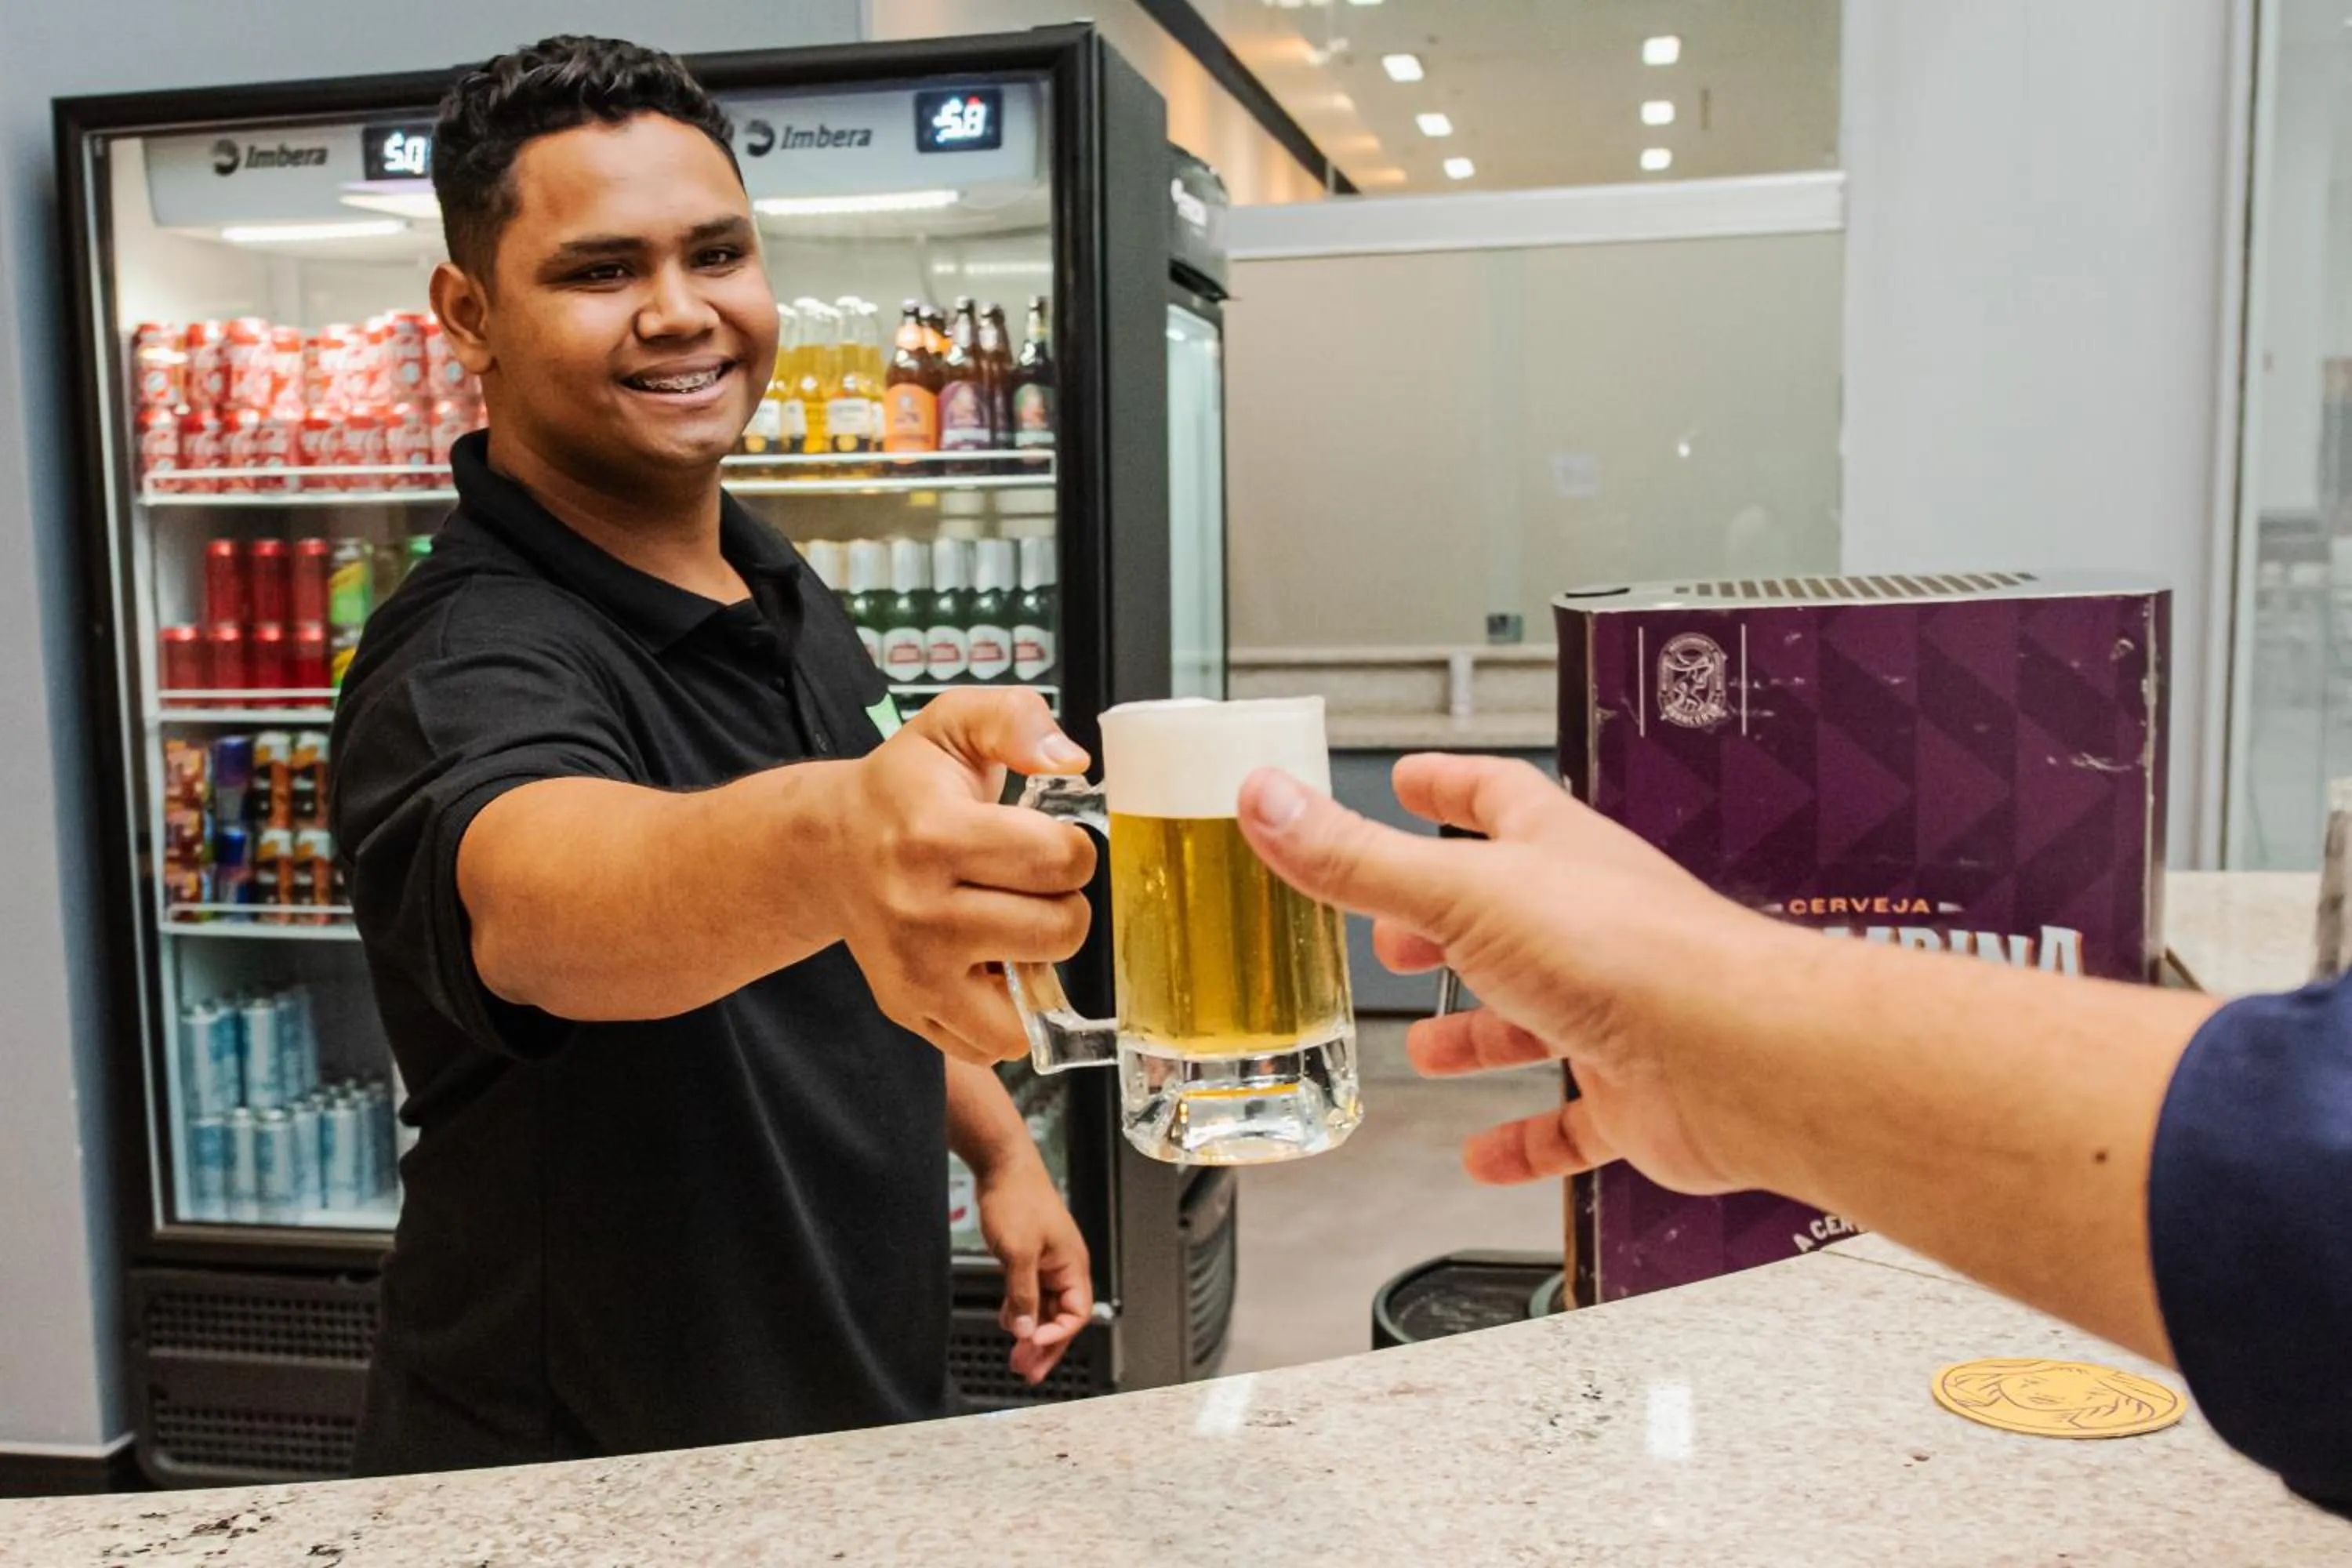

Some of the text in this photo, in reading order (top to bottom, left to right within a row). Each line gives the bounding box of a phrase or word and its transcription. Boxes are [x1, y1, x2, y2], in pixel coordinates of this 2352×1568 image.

[781, 125, 873, 150] Imbera
[245, 143, 328, 169] Imbera
[1788, 897, 1931, 915] CERVEJA
